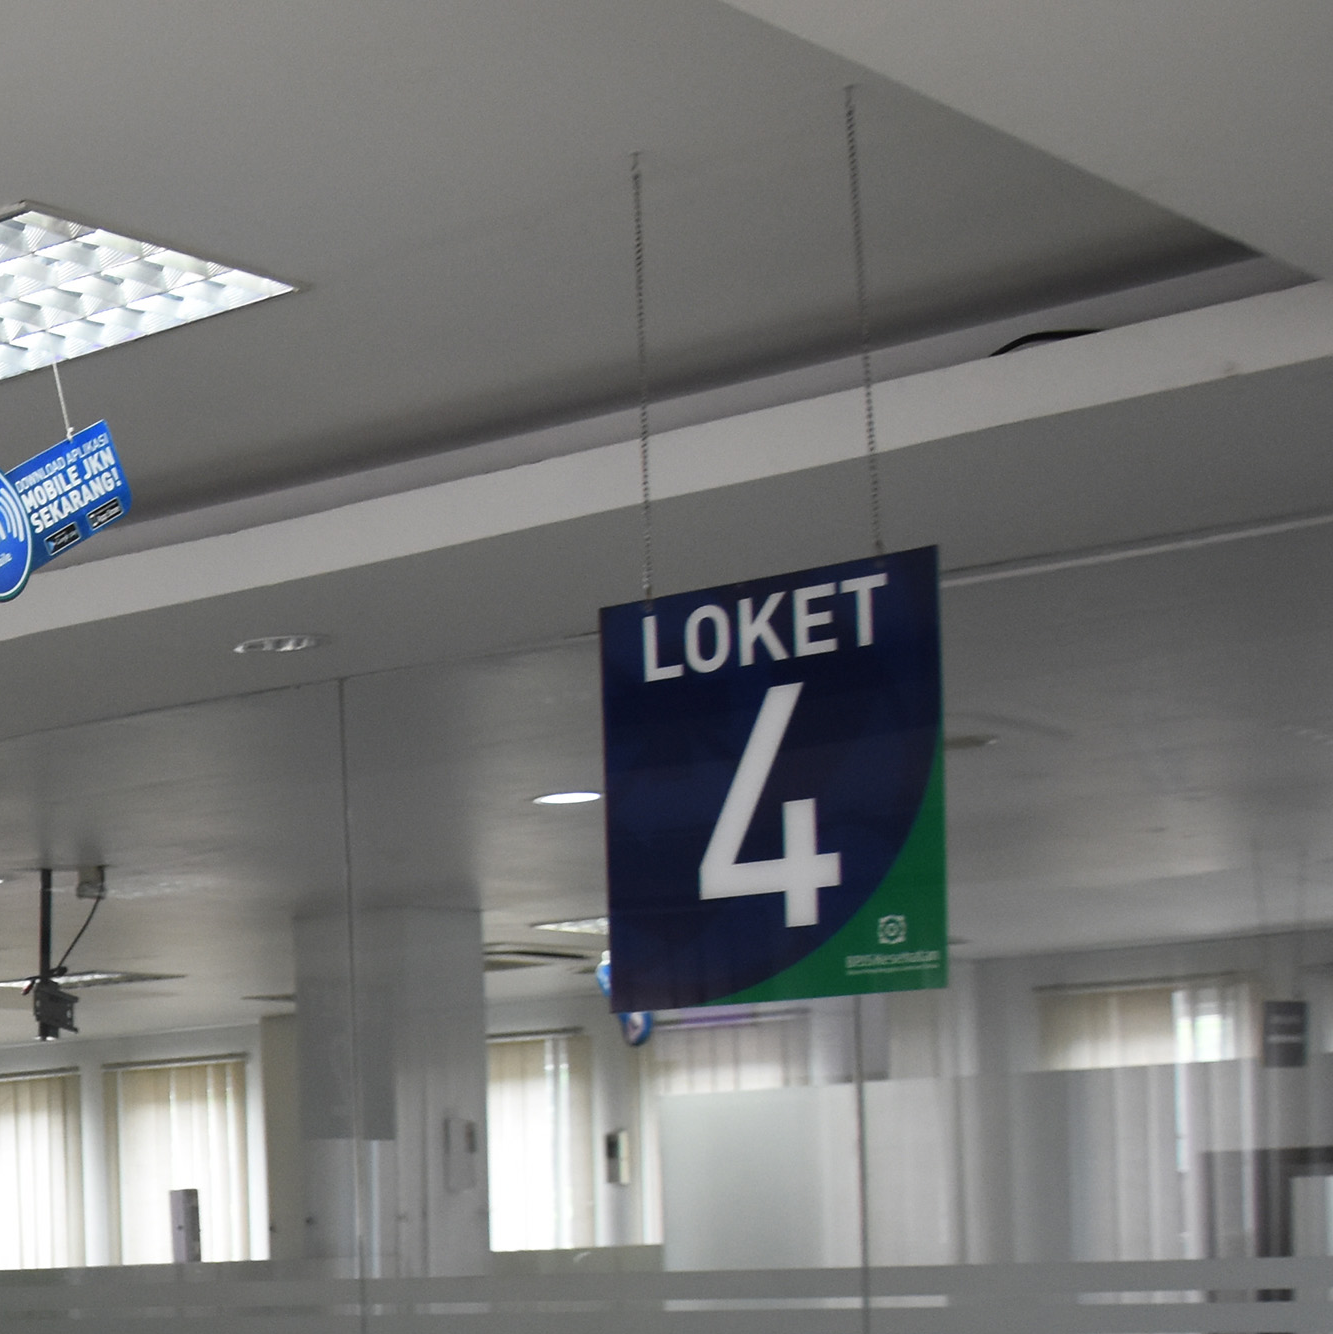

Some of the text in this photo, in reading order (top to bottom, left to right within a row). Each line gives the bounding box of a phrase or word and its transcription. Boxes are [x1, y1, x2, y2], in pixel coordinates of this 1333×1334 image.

[15, 432, 109, 494] DOWNLOAD APLIKASI
[21, 446, 116, 513] MOBILE JKN
[30, 467, 122, 534] SEKARANG!
[642, 573, 889, 683] LOKET
[699, 681, 842, 929] 4
